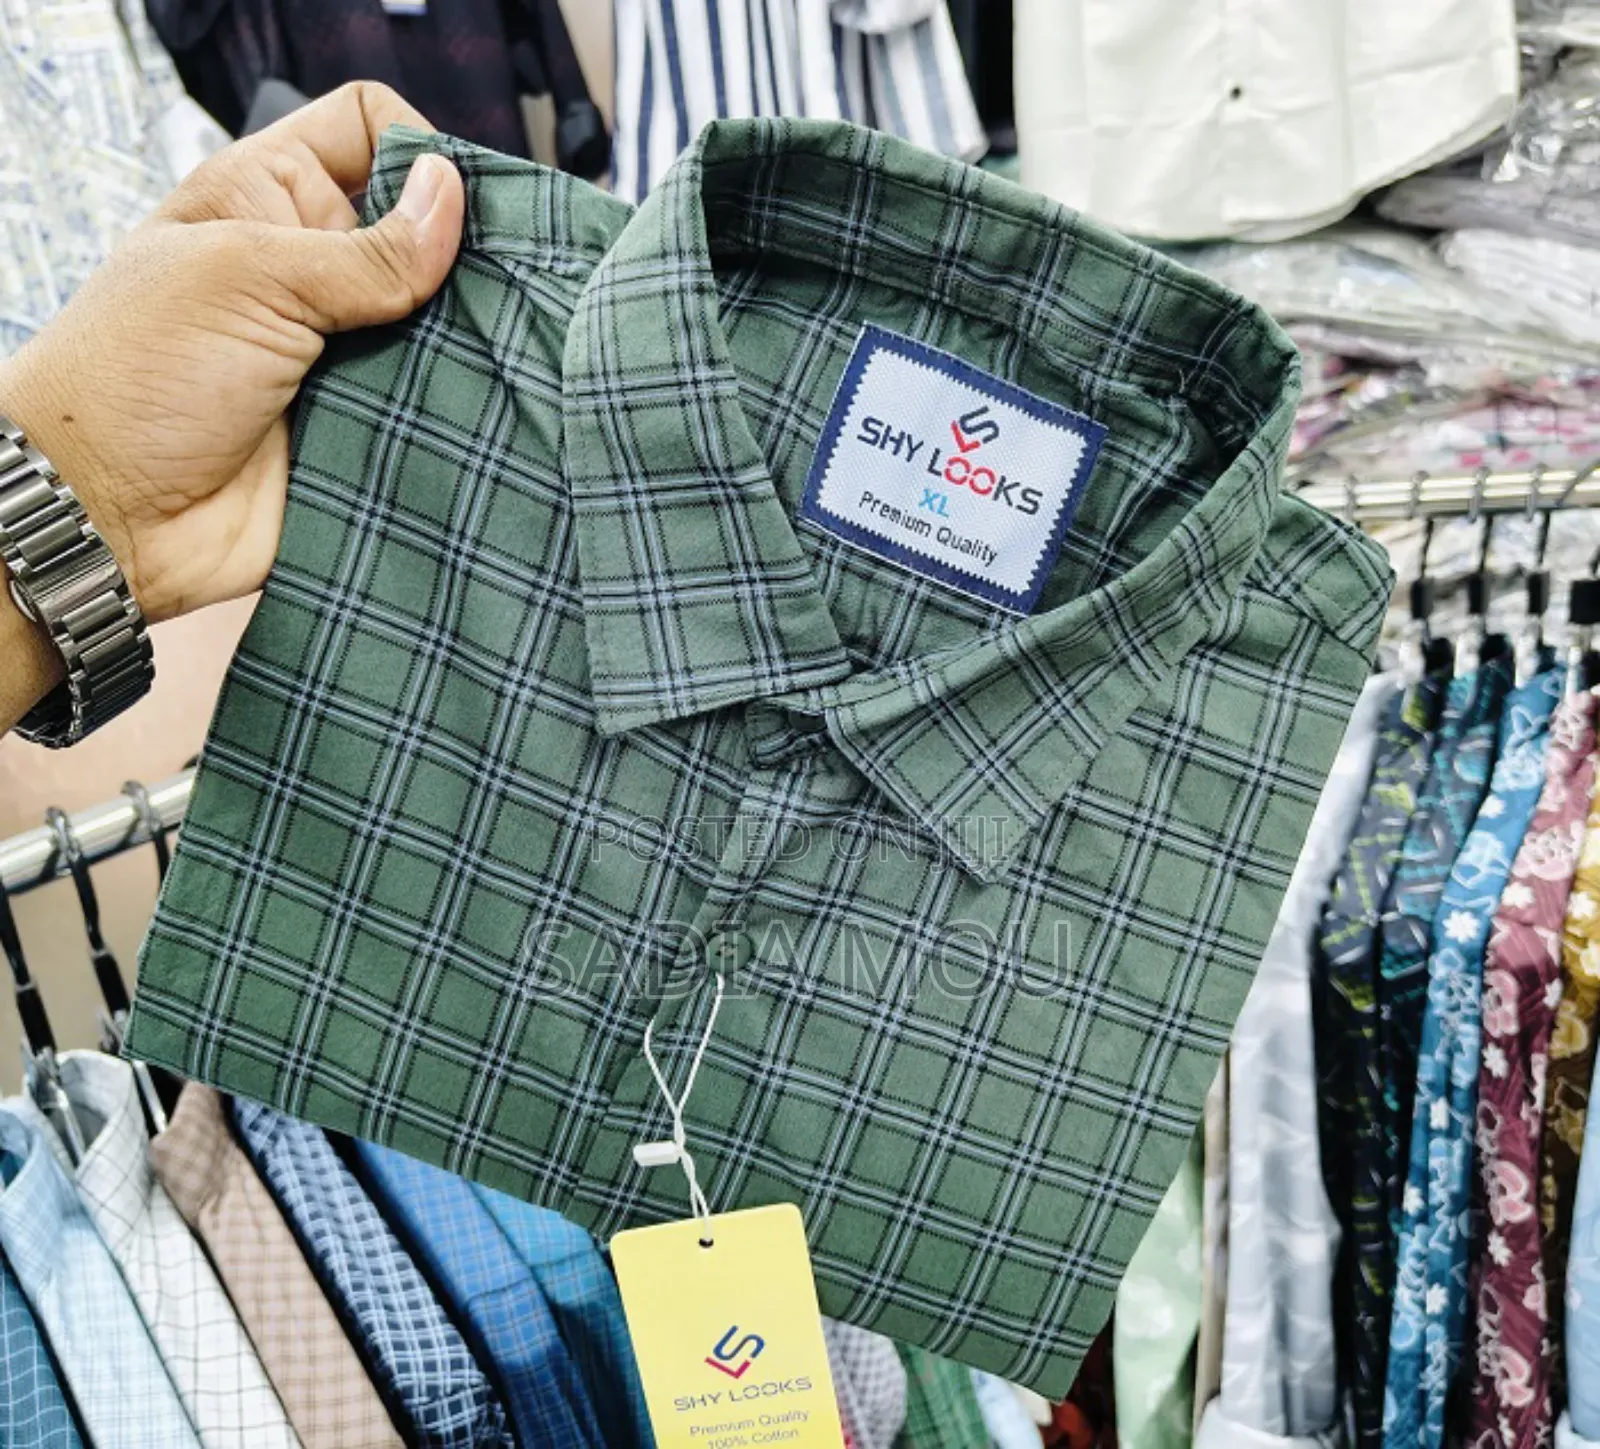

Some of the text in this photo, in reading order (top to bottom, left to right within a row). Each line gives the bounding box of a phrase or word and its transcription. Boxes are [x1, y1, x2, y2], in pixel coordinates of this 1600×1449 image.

[857, 416, 1043, 515] SHY LOOKS
[918, 488, 949, 517] XL
[859, 490, 998, 567] Premium Quality
[674, 1376, 813, 1411] SHY LOOKS
[690, 1410, 809, 1437] Premium Quality
[707, 1427, 799, 1449] 100% Cotton
